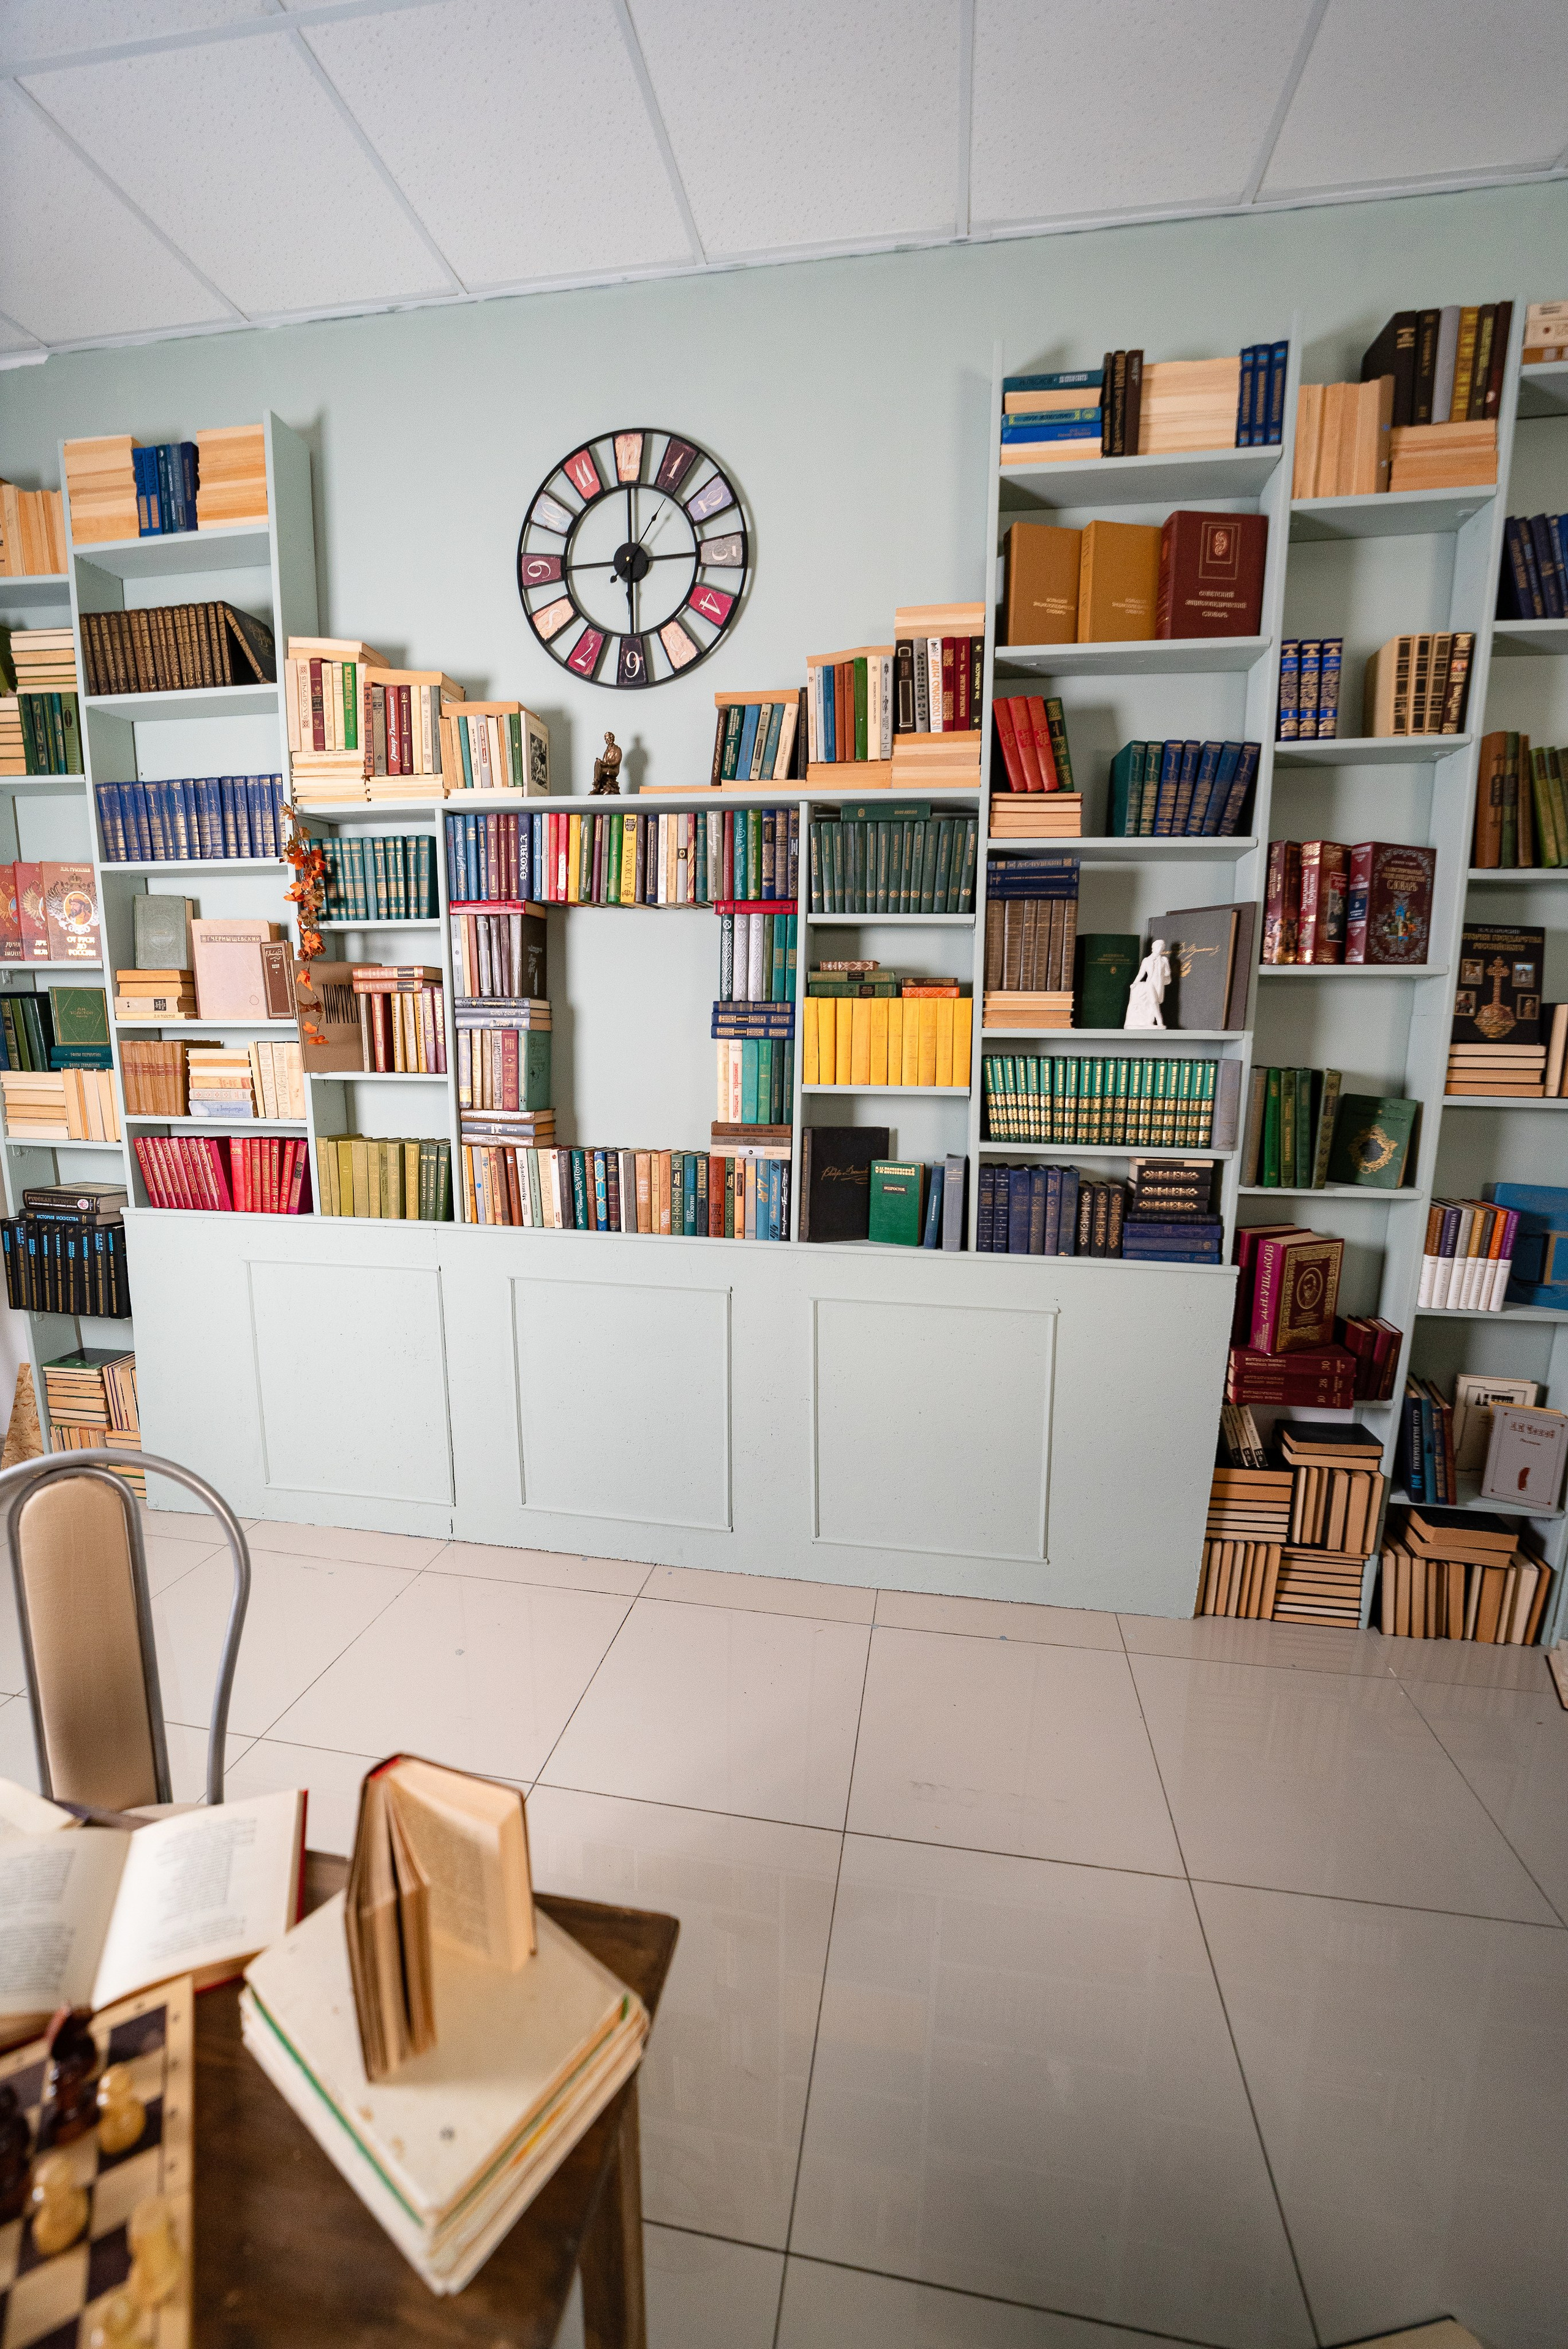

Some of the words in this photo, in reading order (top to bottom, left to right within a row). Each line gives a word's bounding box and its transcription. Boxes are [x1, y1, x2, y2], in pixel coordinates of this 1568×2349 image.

[622, 443, 639, 470] 12
[667, 452, 686, 479] 1
[575, 459, 595, 490] 11
[698, 486, 726, 513] 2
[545, 502, 564, 528] 10
[712, 543, 737, 561] 3
[699, 593, 722, 615] 4
[1185, 599, 1248, 609] ЭНЦИКЛОПЕДИЧЕСКИЙ
[575, 642, 594, 667] 7
[669, 634, 687, 660] 5
[931, 659, 940, 678] МИР
[932, 680, 940, 717] ПОЗНАЮ
[390, 737, 398, 762] Григор
[1300, 869, 1309, 912] Энциклопедия
[1308, 873, 1317, 905] Мудрости
[1387, 880, 1419, 892] СЛОВАРЬ
[423, 993, 432, 1030] ГОРЬКИЙ
[434, 994, 443, 1031] ГОРЬКИЙ
[426, 1032, 433, 1044] М.
[437, 1033, 444, 1045] М.
[574, 1158, 582, 1182] Потоп
[1447, 1213, 1457, 1245] МУШКЕТЕРА
[1259, 1245, 1274, 1320] Д.Н.УШАКОВ
[1321, 1361, 1330, 1371] 30
[1319, 1378, 1328, 1388] 28
